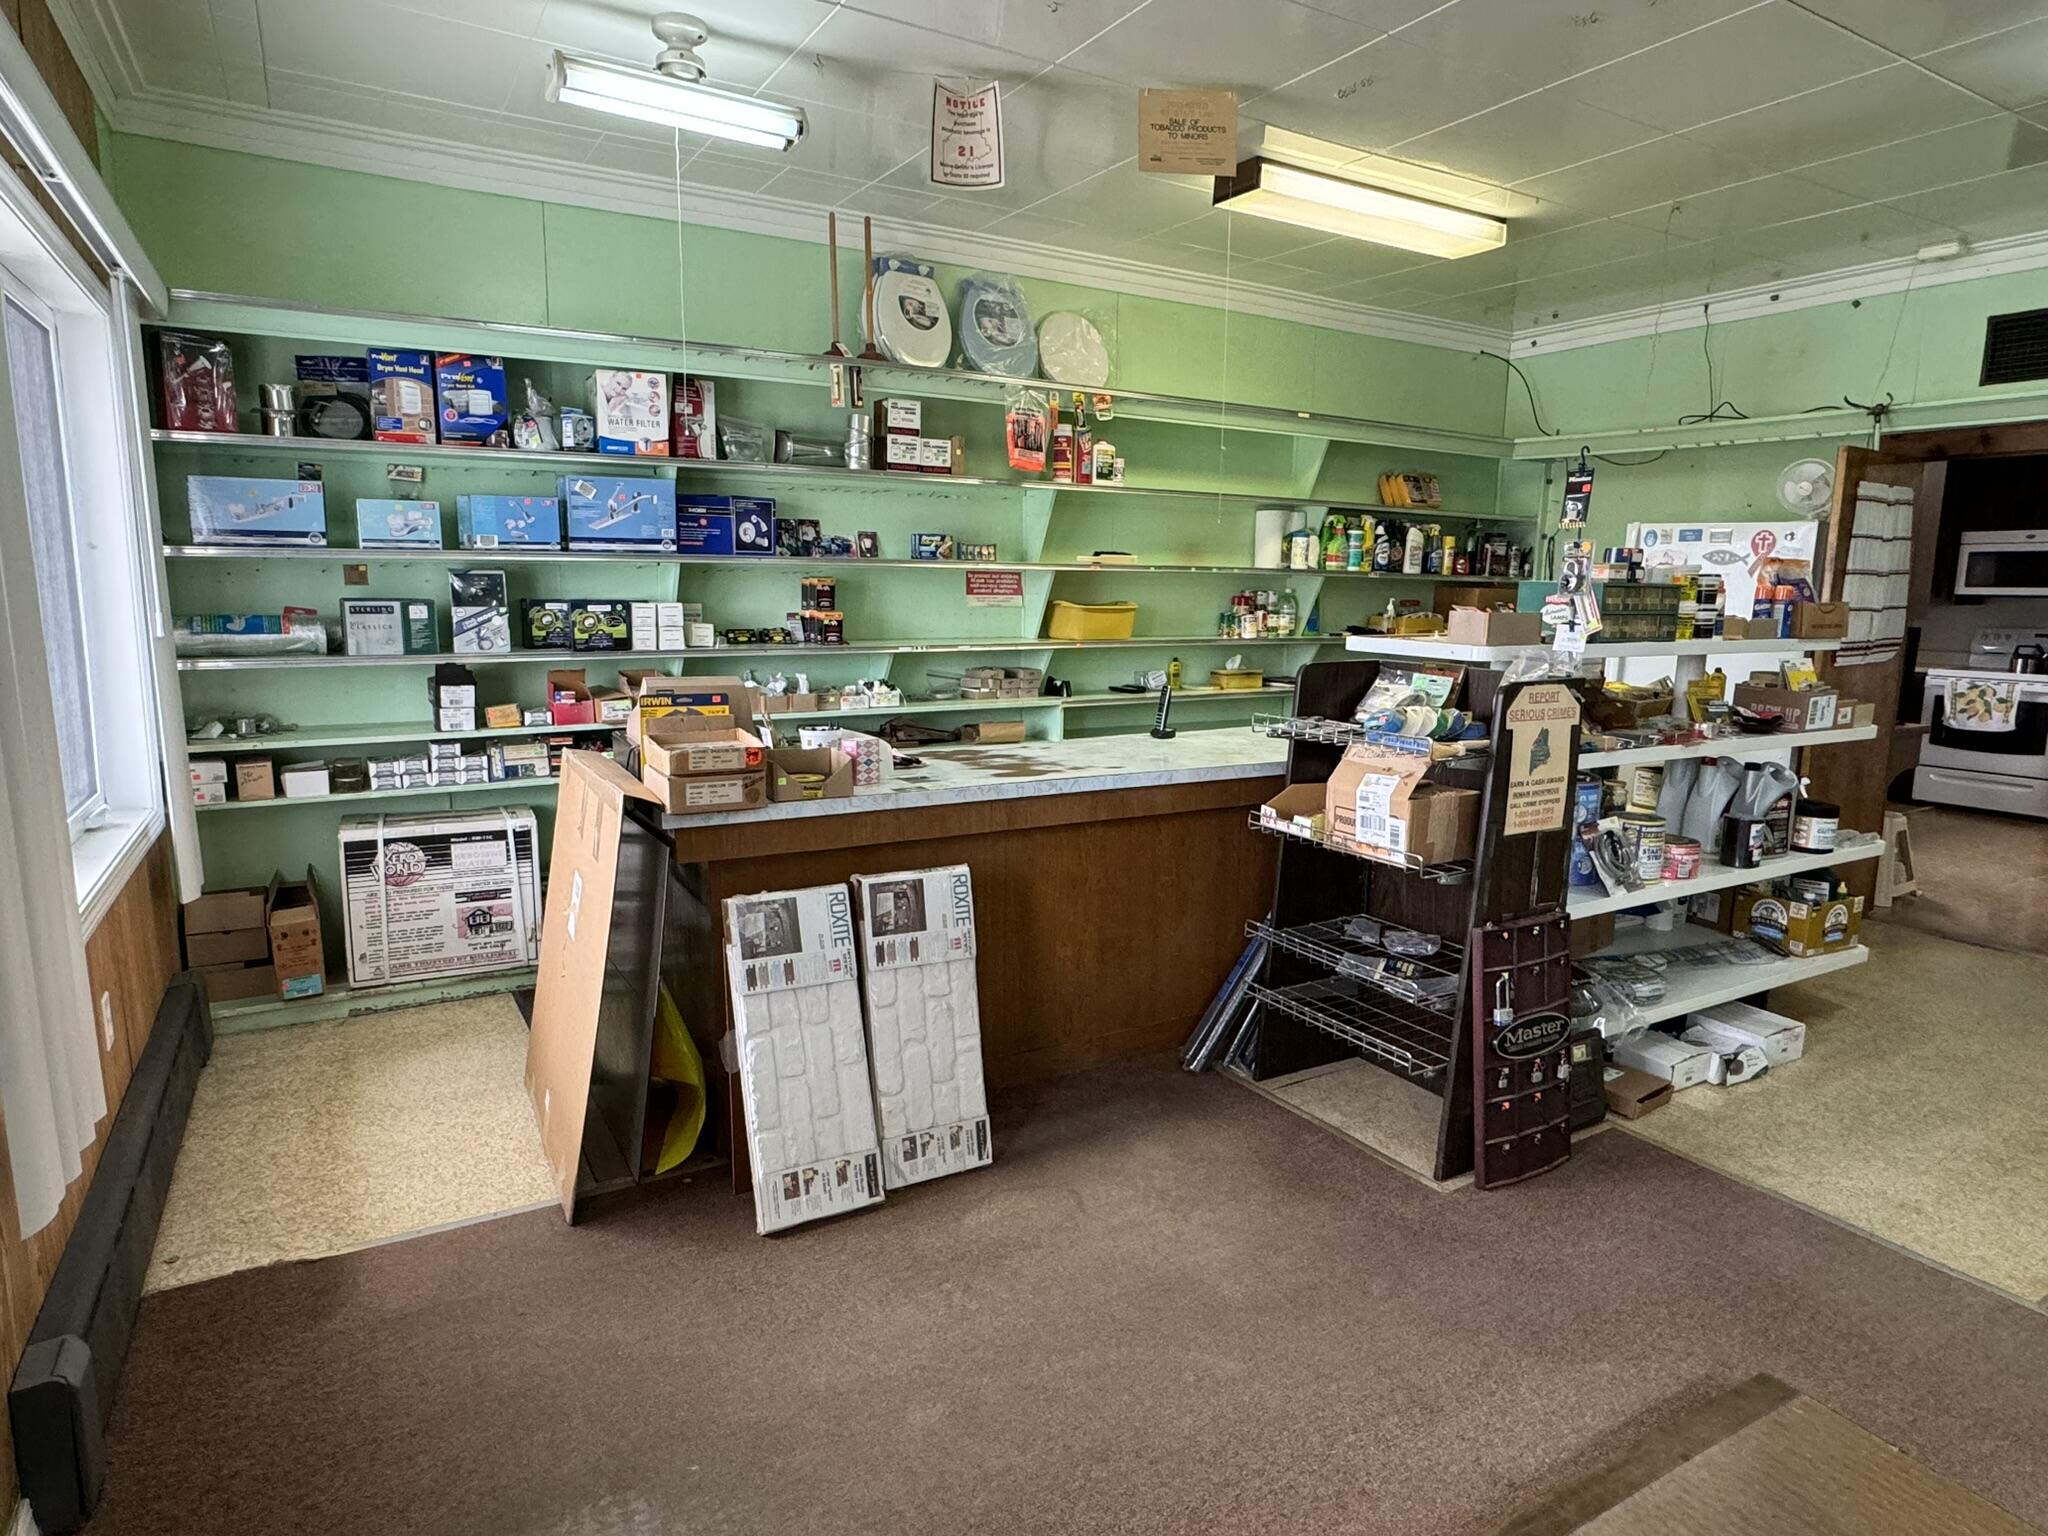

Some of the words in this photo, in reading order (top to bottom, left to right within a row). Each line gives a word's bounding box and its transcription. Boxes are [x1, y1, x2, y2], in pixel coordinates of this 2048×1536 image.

[946, 96, 986, 110] NOTICE
[1169, 118, 1186, 126] SALE
[1150, 123, 1186, 132] TOBACCO
[1188, 125, 1226, 134] PRODUCTS
[958, 146, 974, 156] 21
[376, 364, 394, 374] Dryer
[395, 365, 408, 373] Vent
[409, 366, 424, 374] Head
[608, 418, 634, 426] WATER
[636, 419, 661, 428] FILTER
[640, 697, 672, 706] IRWIN
[1529, 691, 1560, 702] REPORT
[1509, 709, 1545, 720] SERIOUS
[1547, 707, 1576, 719] CRIMES
[1785, 708, 1800, 722] UP
[1531, 778, 1545, 786] CASH
[1336, 814, 1356, 826] PRODU
[384, 850, 418, 864] KERO
[454, 860, 492, 868] HEATER
[952, 874, 972, 927] ROXITE
[829, 891, 852, 948] ROXITE
[390, 962, 412, 970] AME
[414, 957, 455, 968] TRUSTED
[456, 954, 467, 962] BY
[1504, 1020, 1564, 1047] Master
